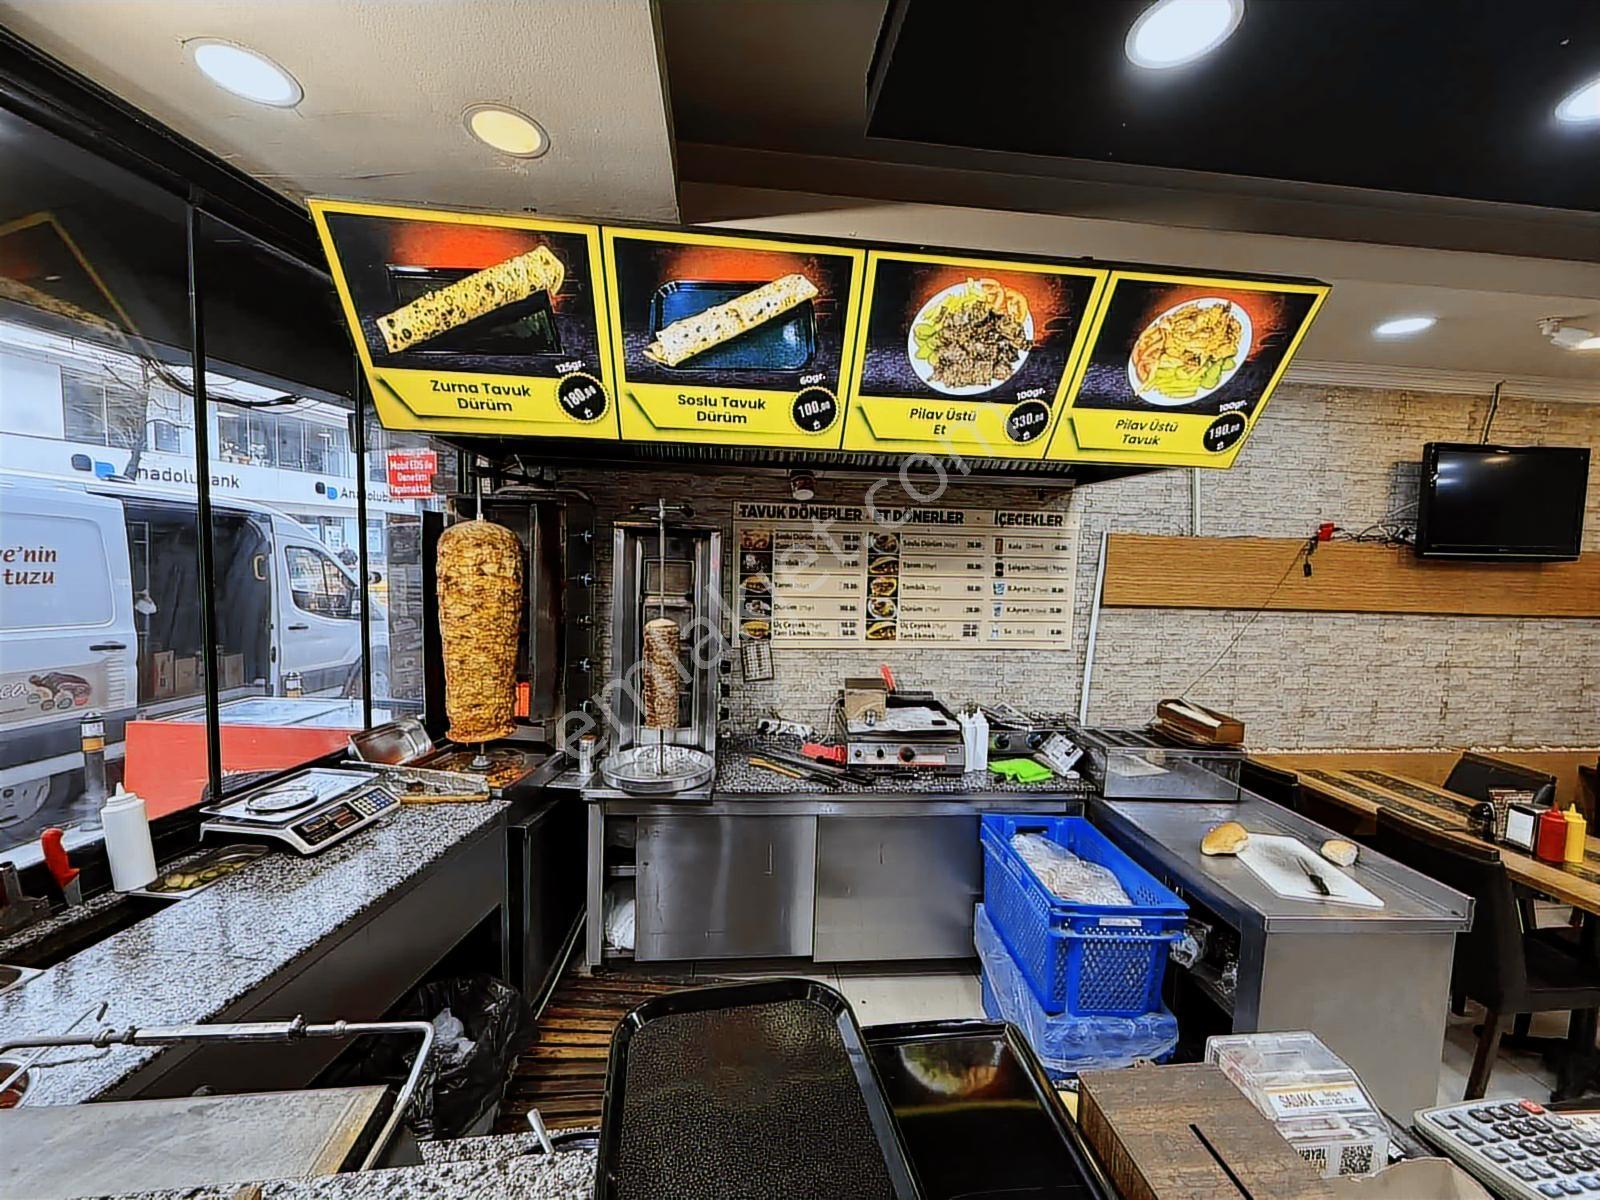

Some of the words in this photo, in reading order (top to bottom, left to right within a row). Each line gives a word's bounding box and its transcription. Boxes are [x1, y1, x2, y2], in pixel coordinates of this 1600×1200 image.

[430, 380, 479, 394] Zurna
[482, 383, 531, 397] Tavuk
[457, 398, 513, 411] Dürüm
[678, 394, 717, 407] Soslu
[721, 396, 766, 410] Tavuk
[697, 411, 747, 424] Dürüm
[909, 407, 943, 420] Pilav
[946, 407, 976, 421] Üstü
[933, 424, 946, 435] Et
[1115, 419, 1149, 431] Pilav
[1150, 419, 1178, 432] Üstü
[1122, 434, 1161, 445] Tavuk
[740, 504, 786, 519] TAVUK
[789, 503, 863, 521] DÖNERLER
[875, 508, 891, 521] ET
[893, 505, 964, 524] DÖNERLER
[994, 508, 1063, 528] İÇECEKLER
[0, 546, 56, 563] e'nin
[2, 568, 54, 585] tuzu
